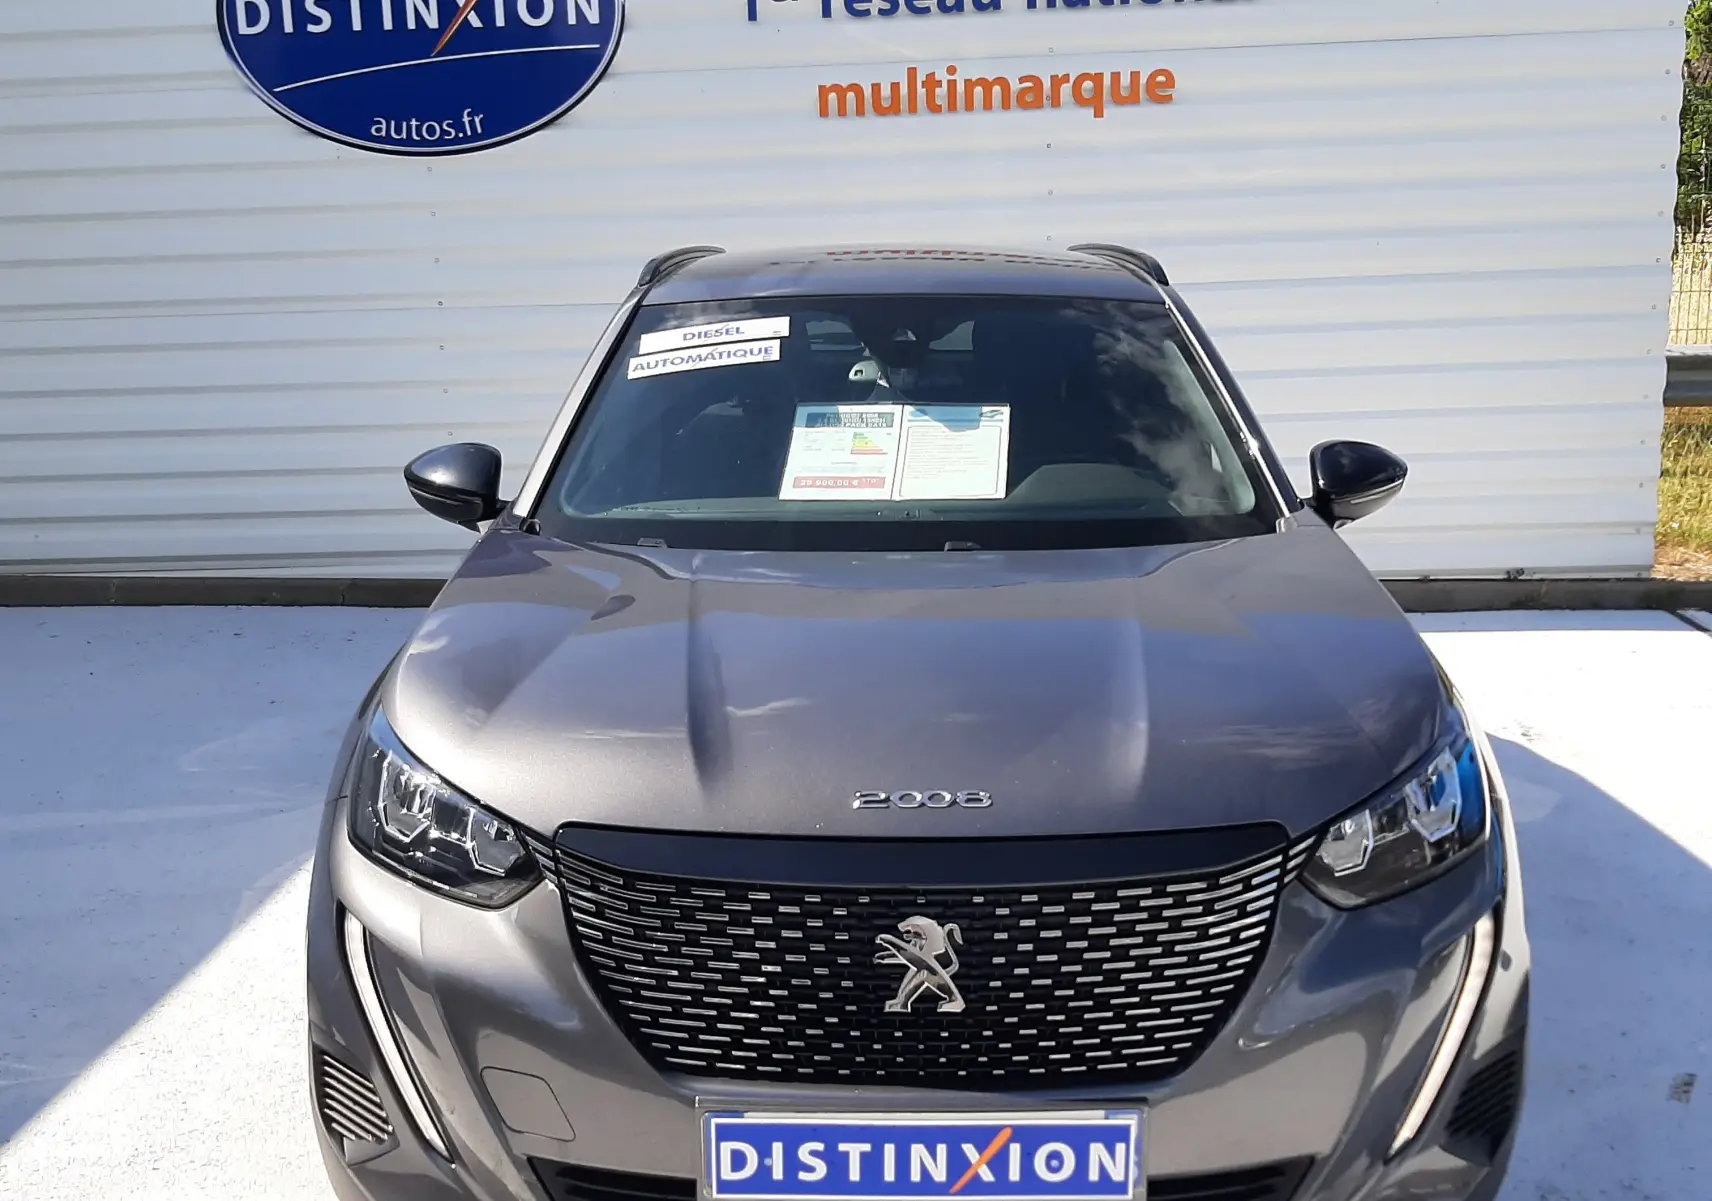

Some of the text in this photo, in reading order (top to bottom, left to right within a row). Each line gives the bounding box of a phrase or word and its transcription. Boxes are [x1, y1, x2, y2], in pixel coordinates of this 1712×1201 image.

[818, 65, 1176, 119] multimarque
[370, 107, 484, 140] autos.fr
[682, 326, 745, 341] DIESEL
[632, 345, 774, 372] AUTOMATIQUE
[852, 789, 994, 809] 2008
[719, 1129, 1126, 1191] DISTINXION
